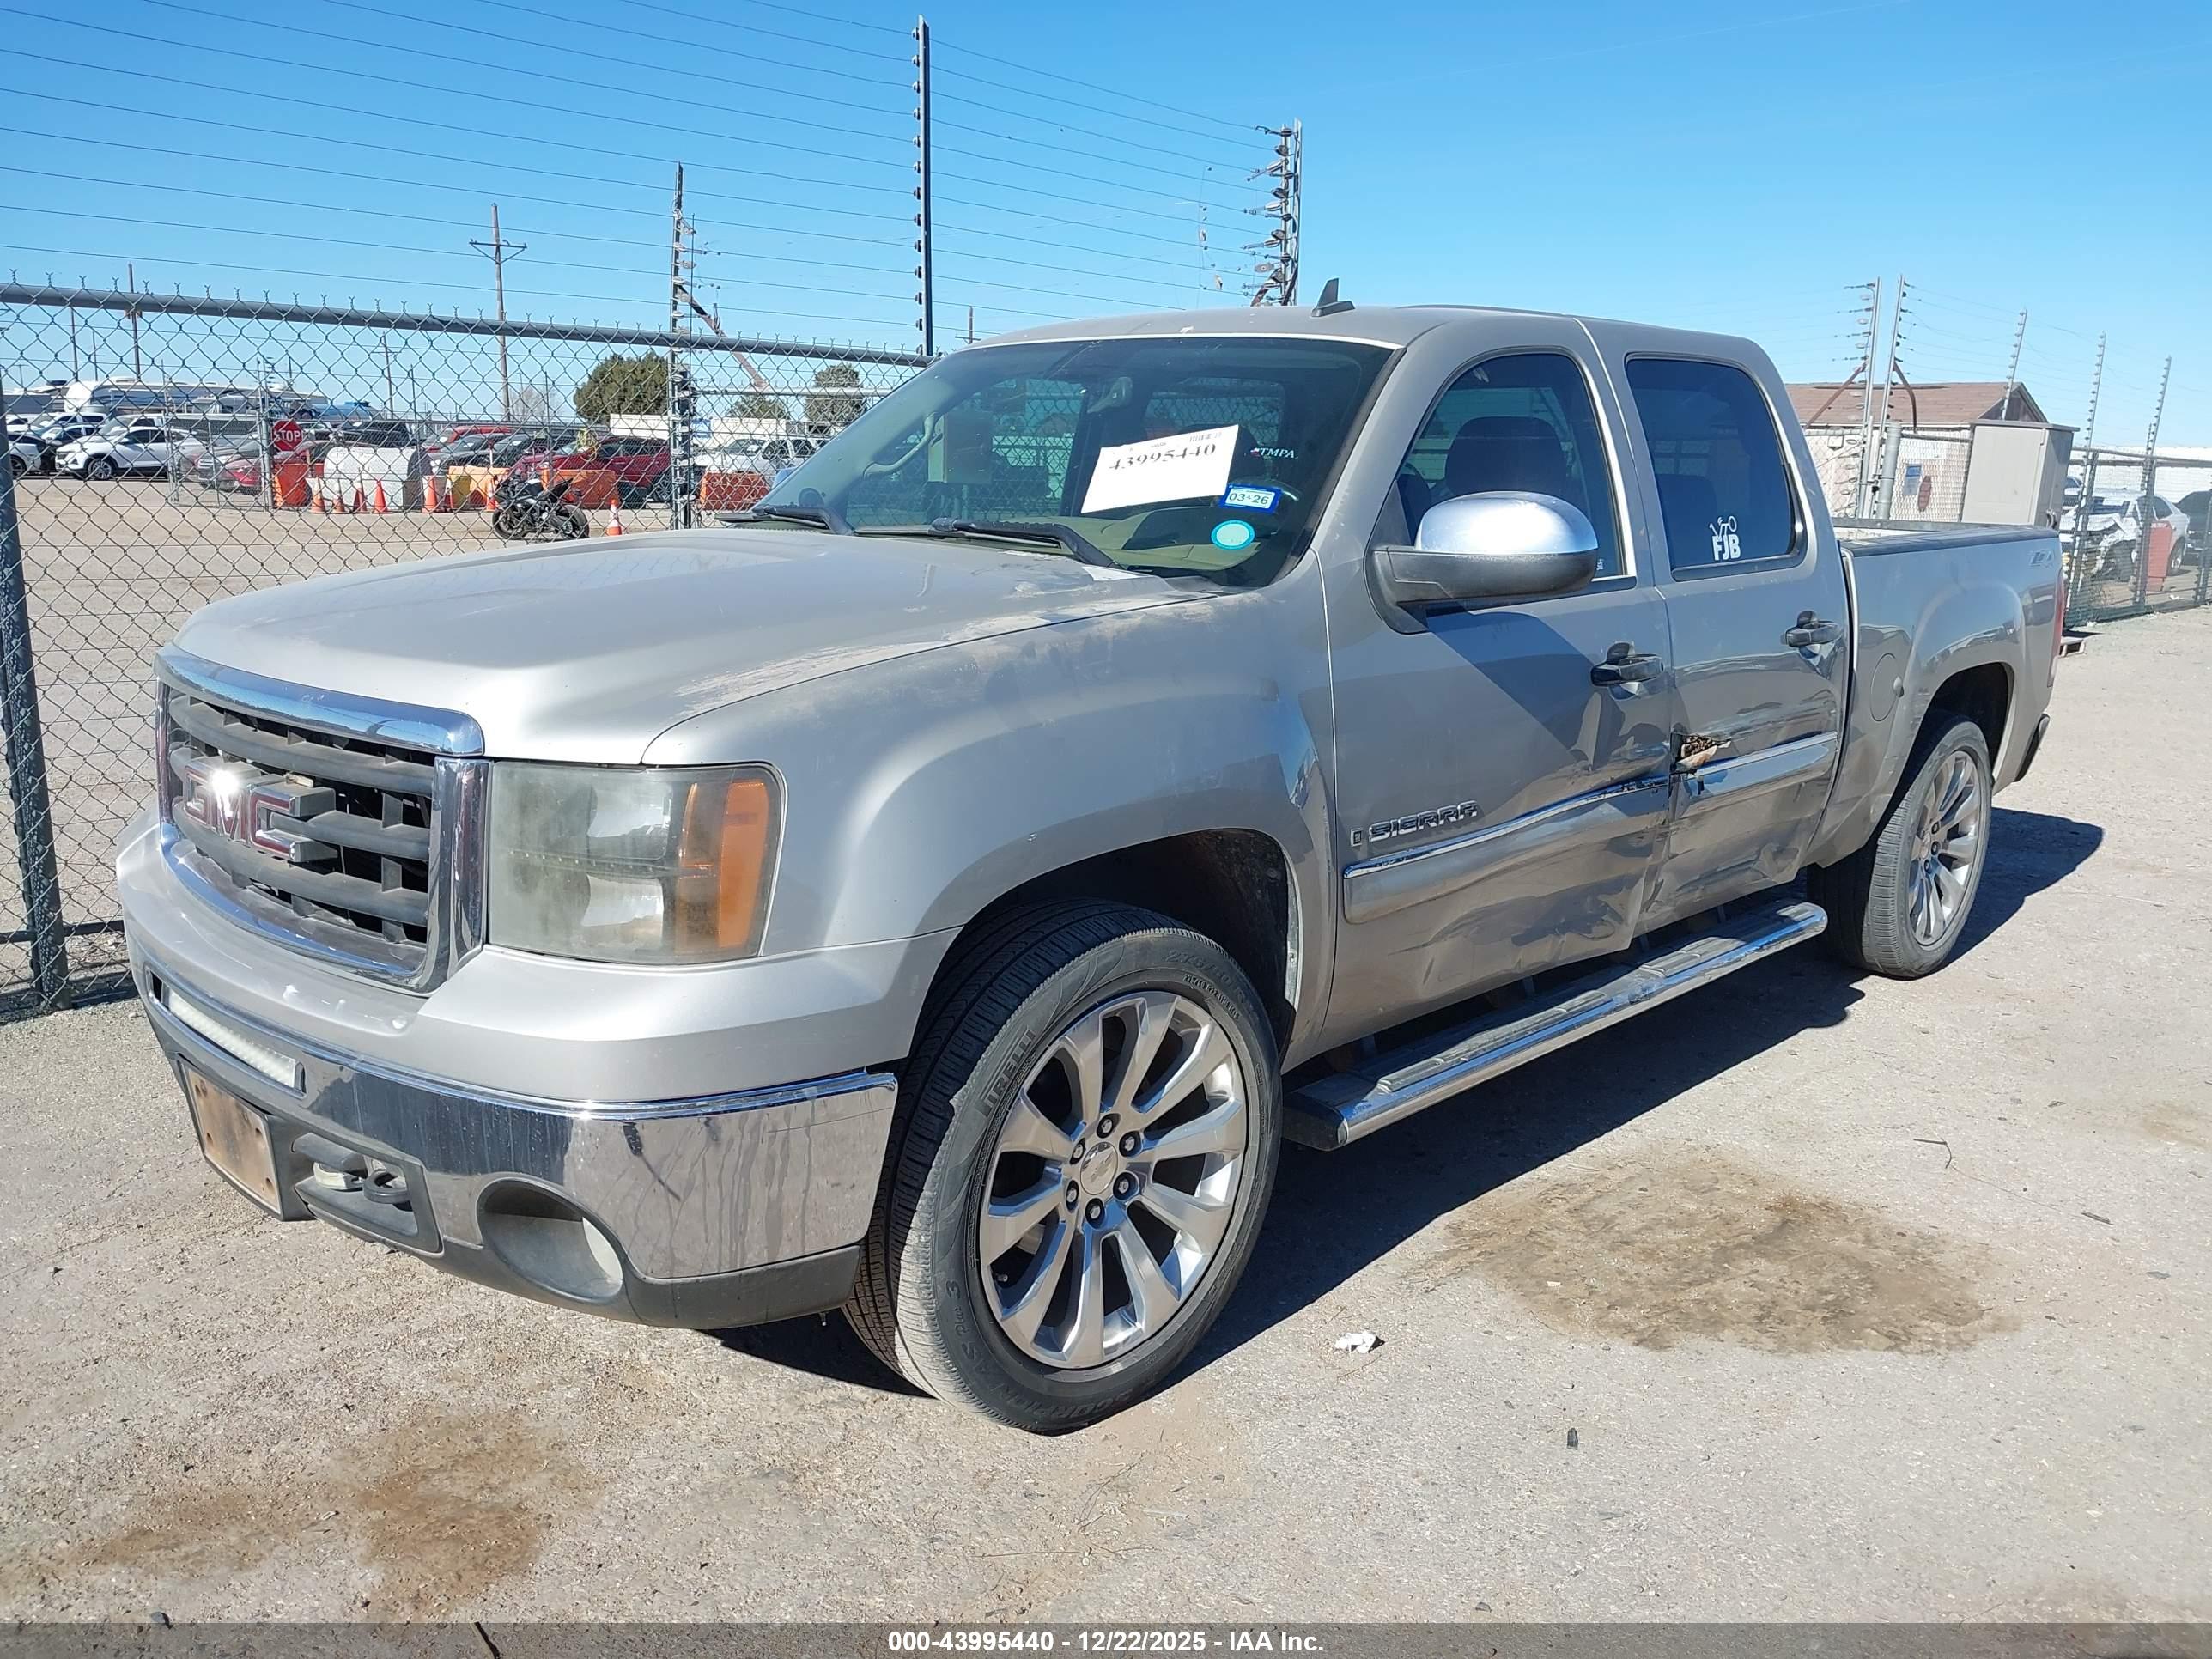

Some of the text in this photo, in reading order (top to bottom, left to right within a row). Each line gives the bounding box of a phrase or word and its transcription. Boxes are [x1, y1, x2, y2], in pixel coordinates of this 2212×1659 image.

[274, 429, 301, 442] STOP
[1109, 443, 1216, 470] 43995440
[1260, 447, 1295, 458] TMPA
[1712, 534, 1741, 561] FJB
[183, 765, 301, 862] GMC
[1369, 800, 1477, 842] SIERRA
[975, 1024, 1036, 1117] PIRELLI
